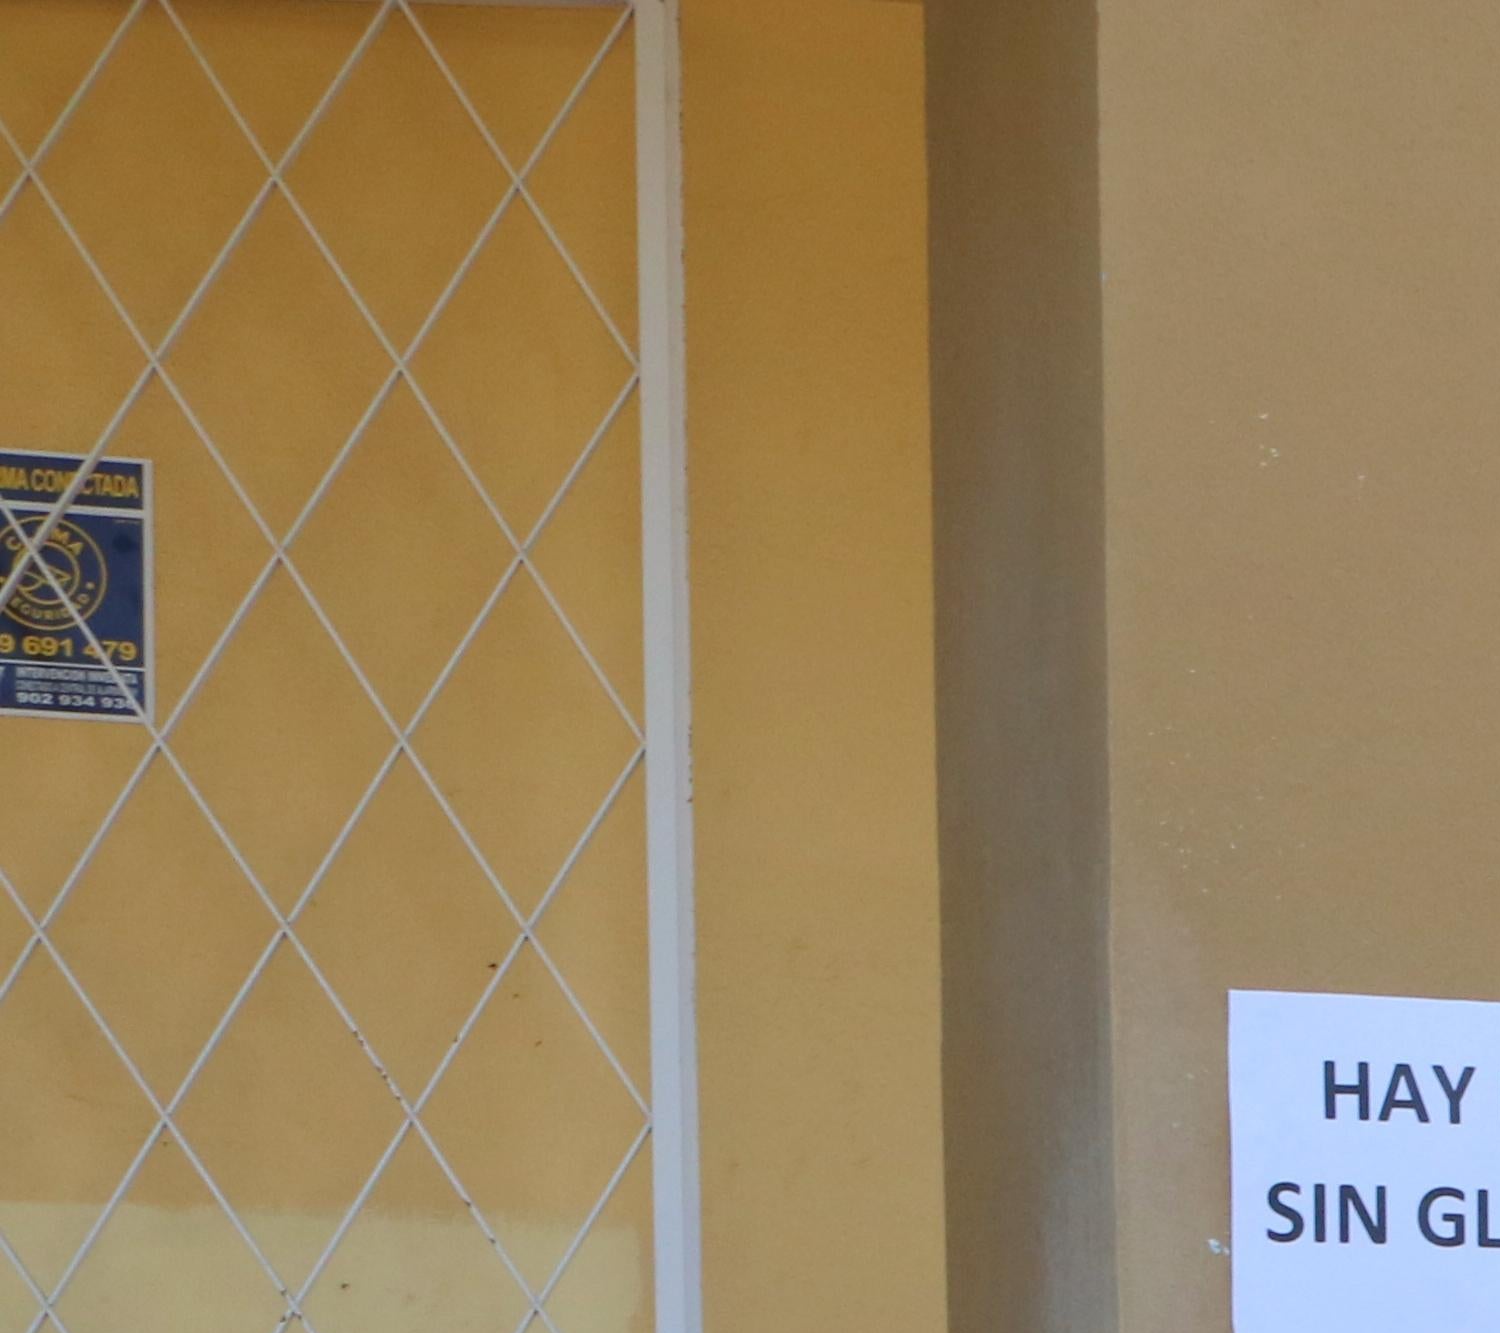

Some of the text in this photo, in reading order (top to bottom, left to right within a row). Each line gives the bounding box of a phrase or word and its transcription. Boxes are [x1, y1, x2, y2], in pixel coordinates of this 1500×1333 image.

[31, 468, 139, 498] CONCTADA
[22, 635, 73, 657] 691
[17, 692, 54, 705] 902
[59, 694, 95, 707] 934
[1323, 1060, 1476, 1125] HAY
[1266, 1182, 1387, 1245] SIN
